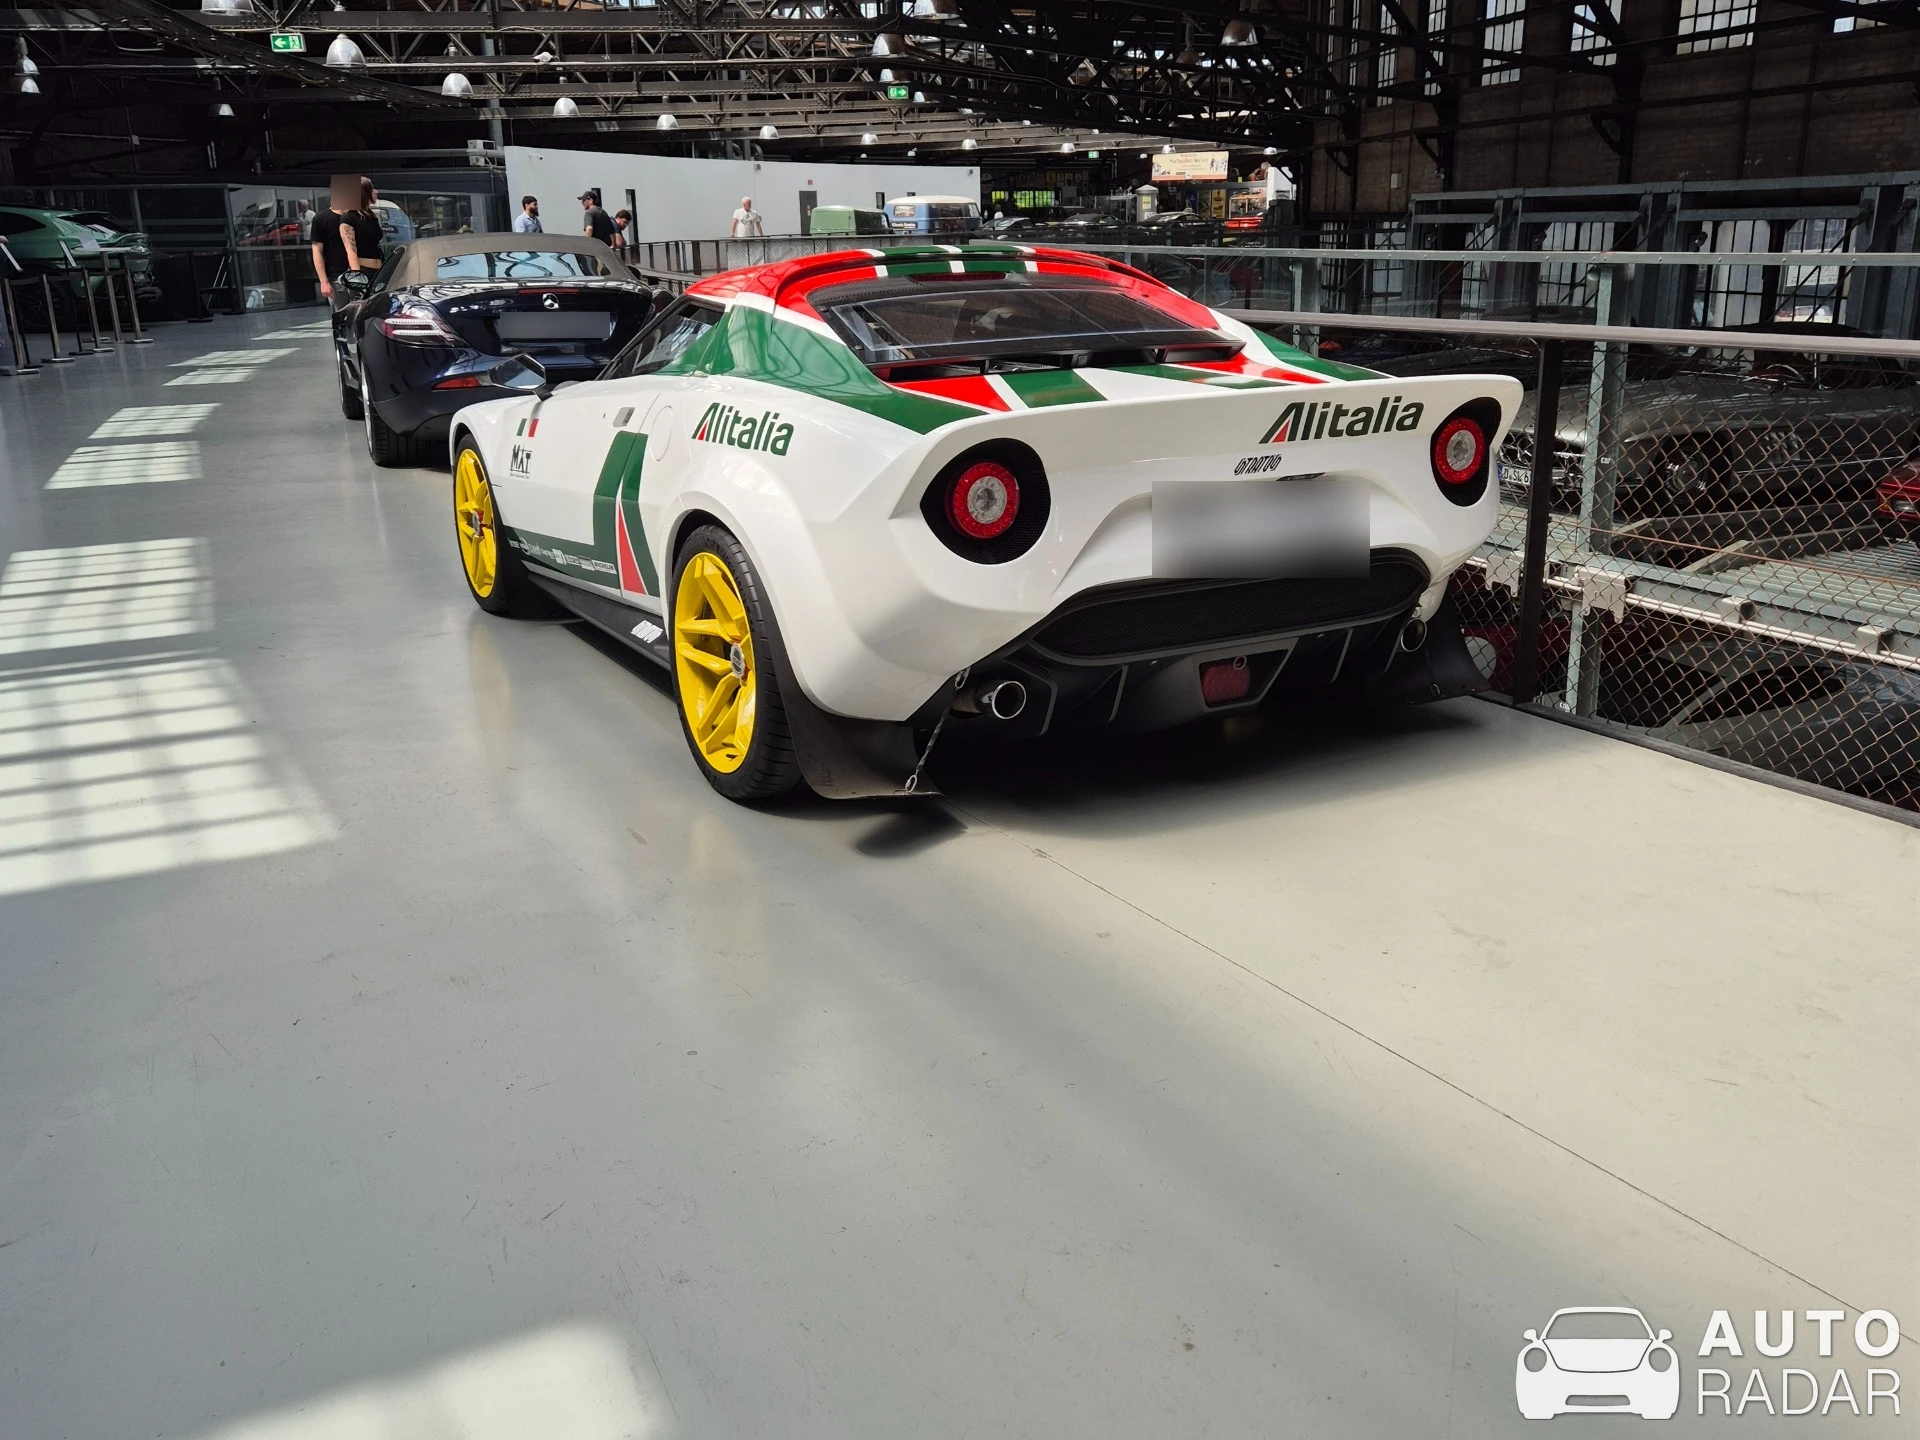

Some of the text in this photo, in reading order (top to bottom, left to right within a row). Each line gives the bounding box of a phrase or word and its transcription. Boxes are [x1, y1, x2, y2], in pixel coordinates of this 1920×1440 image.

[692, 402, 795, 456] Alitalia
[1258, 396, 1425, 445] Alitalia
[1234, 454, 1282, 476] STRATOS
